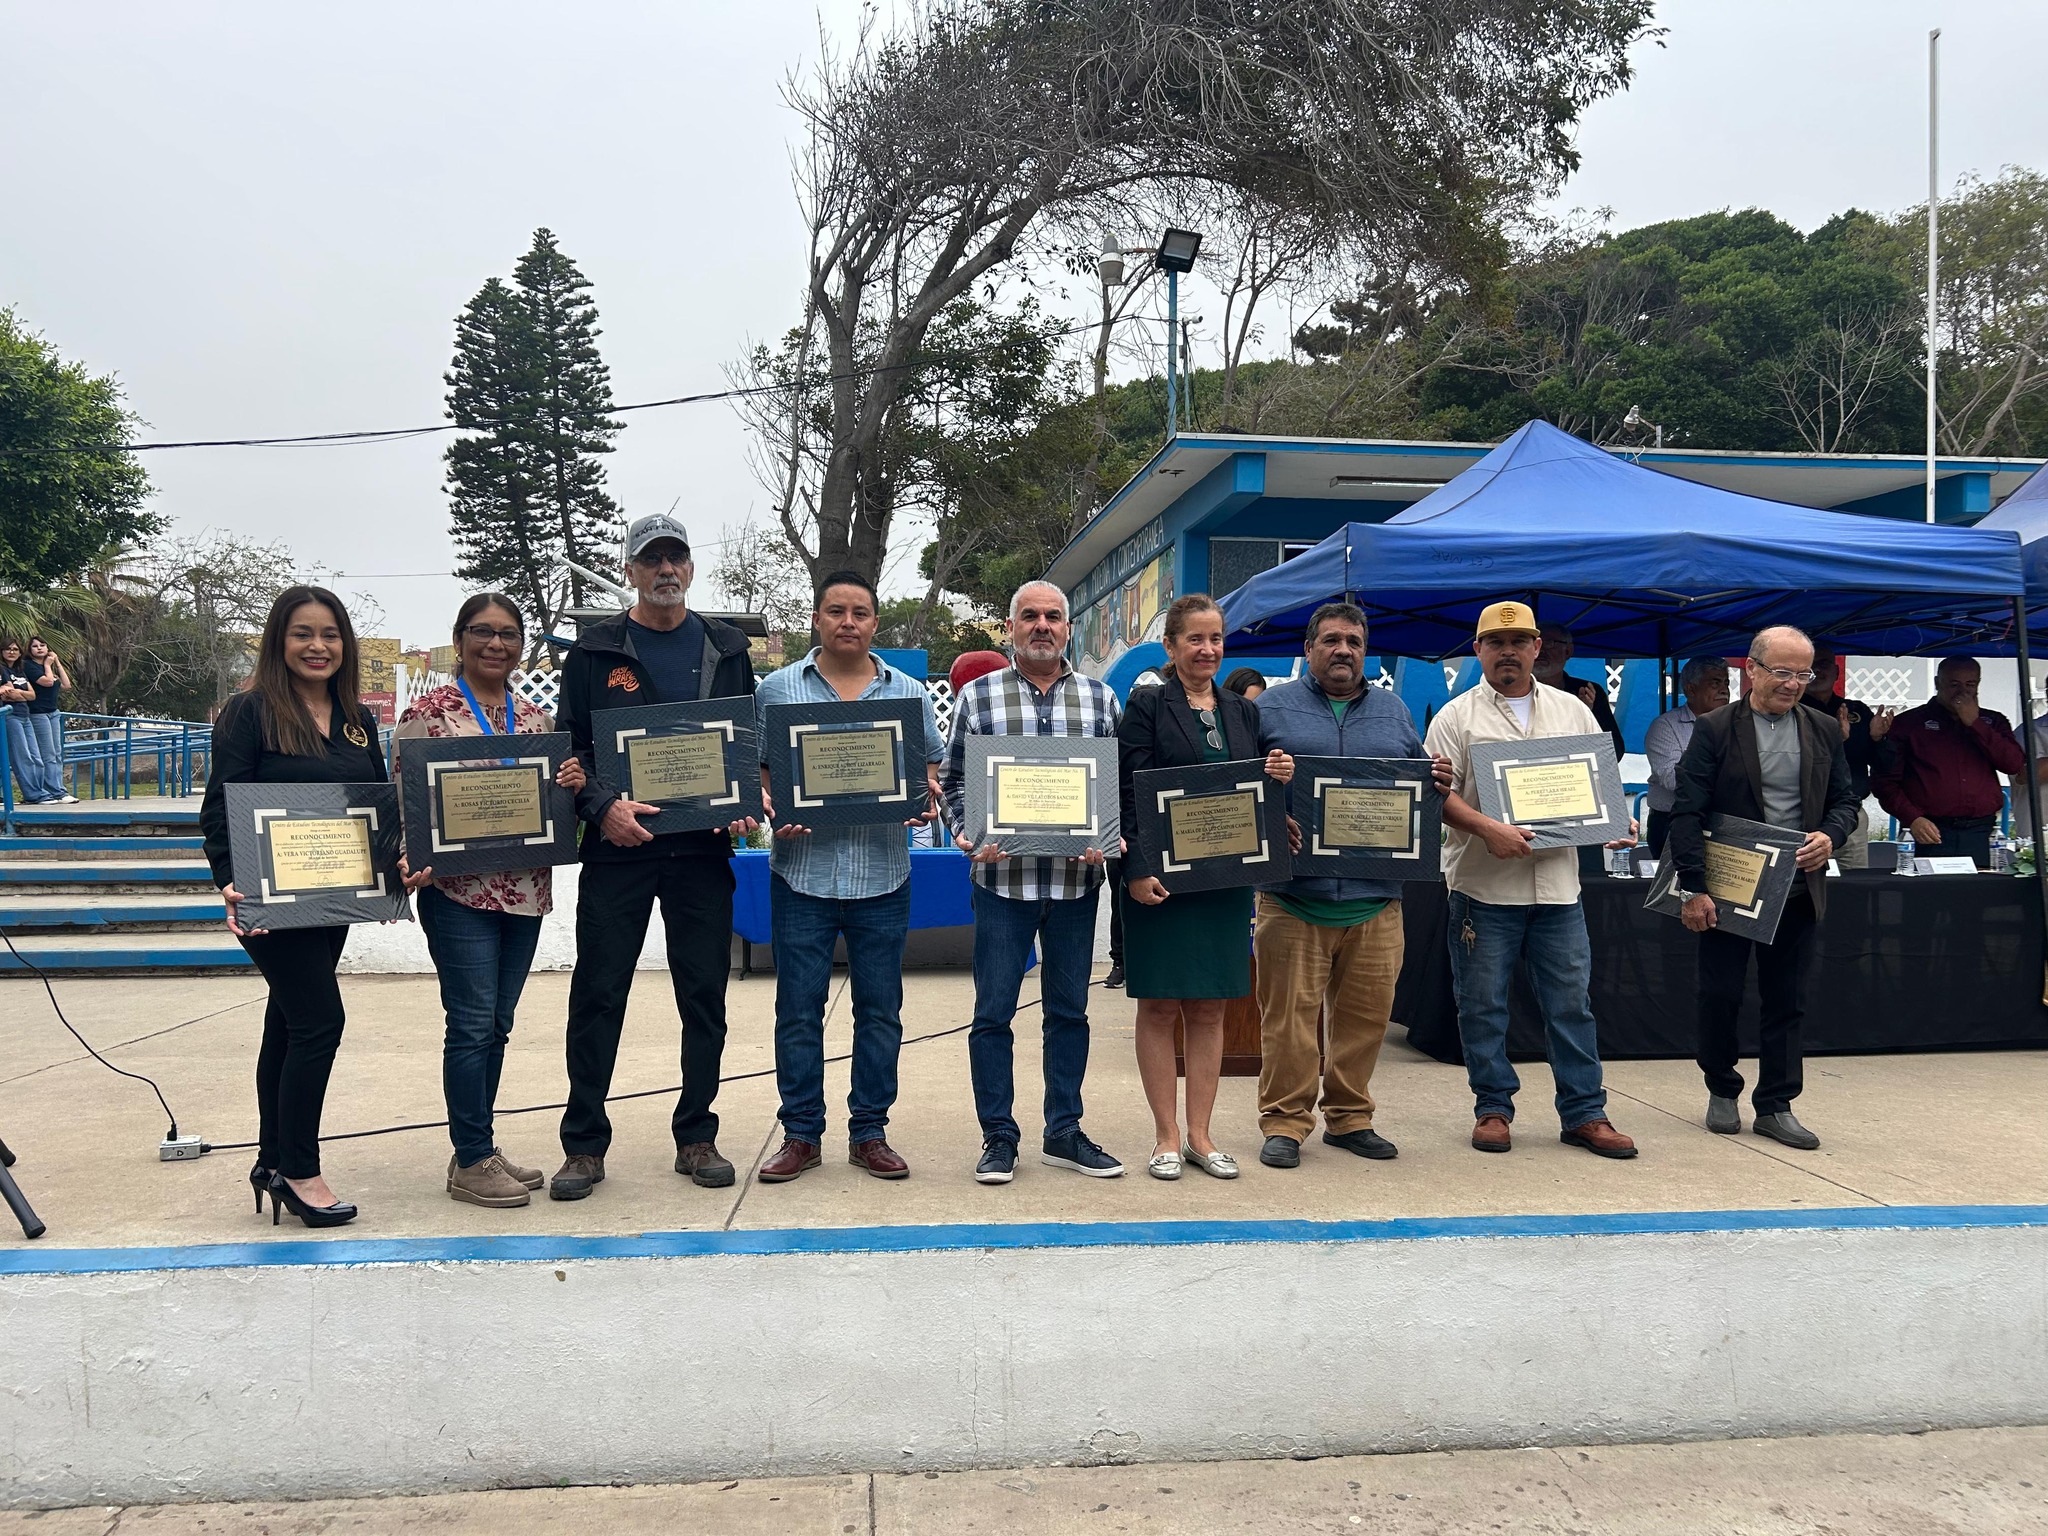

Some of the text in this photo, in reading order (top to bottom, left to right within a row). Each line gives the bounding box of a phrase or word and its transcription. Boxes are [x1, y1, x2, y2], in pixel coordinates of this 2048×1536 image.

[647, 746, 705, 757] RECONOCIMIENTO
[820, 744, 875, 752] RECONOCIMIENTO
[1523, 774, 1574, 782] RECONOCIMIENTO
[461, 783, 521, 791] RECONOCIMIENTO
[1186, 807, 1239, 817] RECONOCIMIENTO
